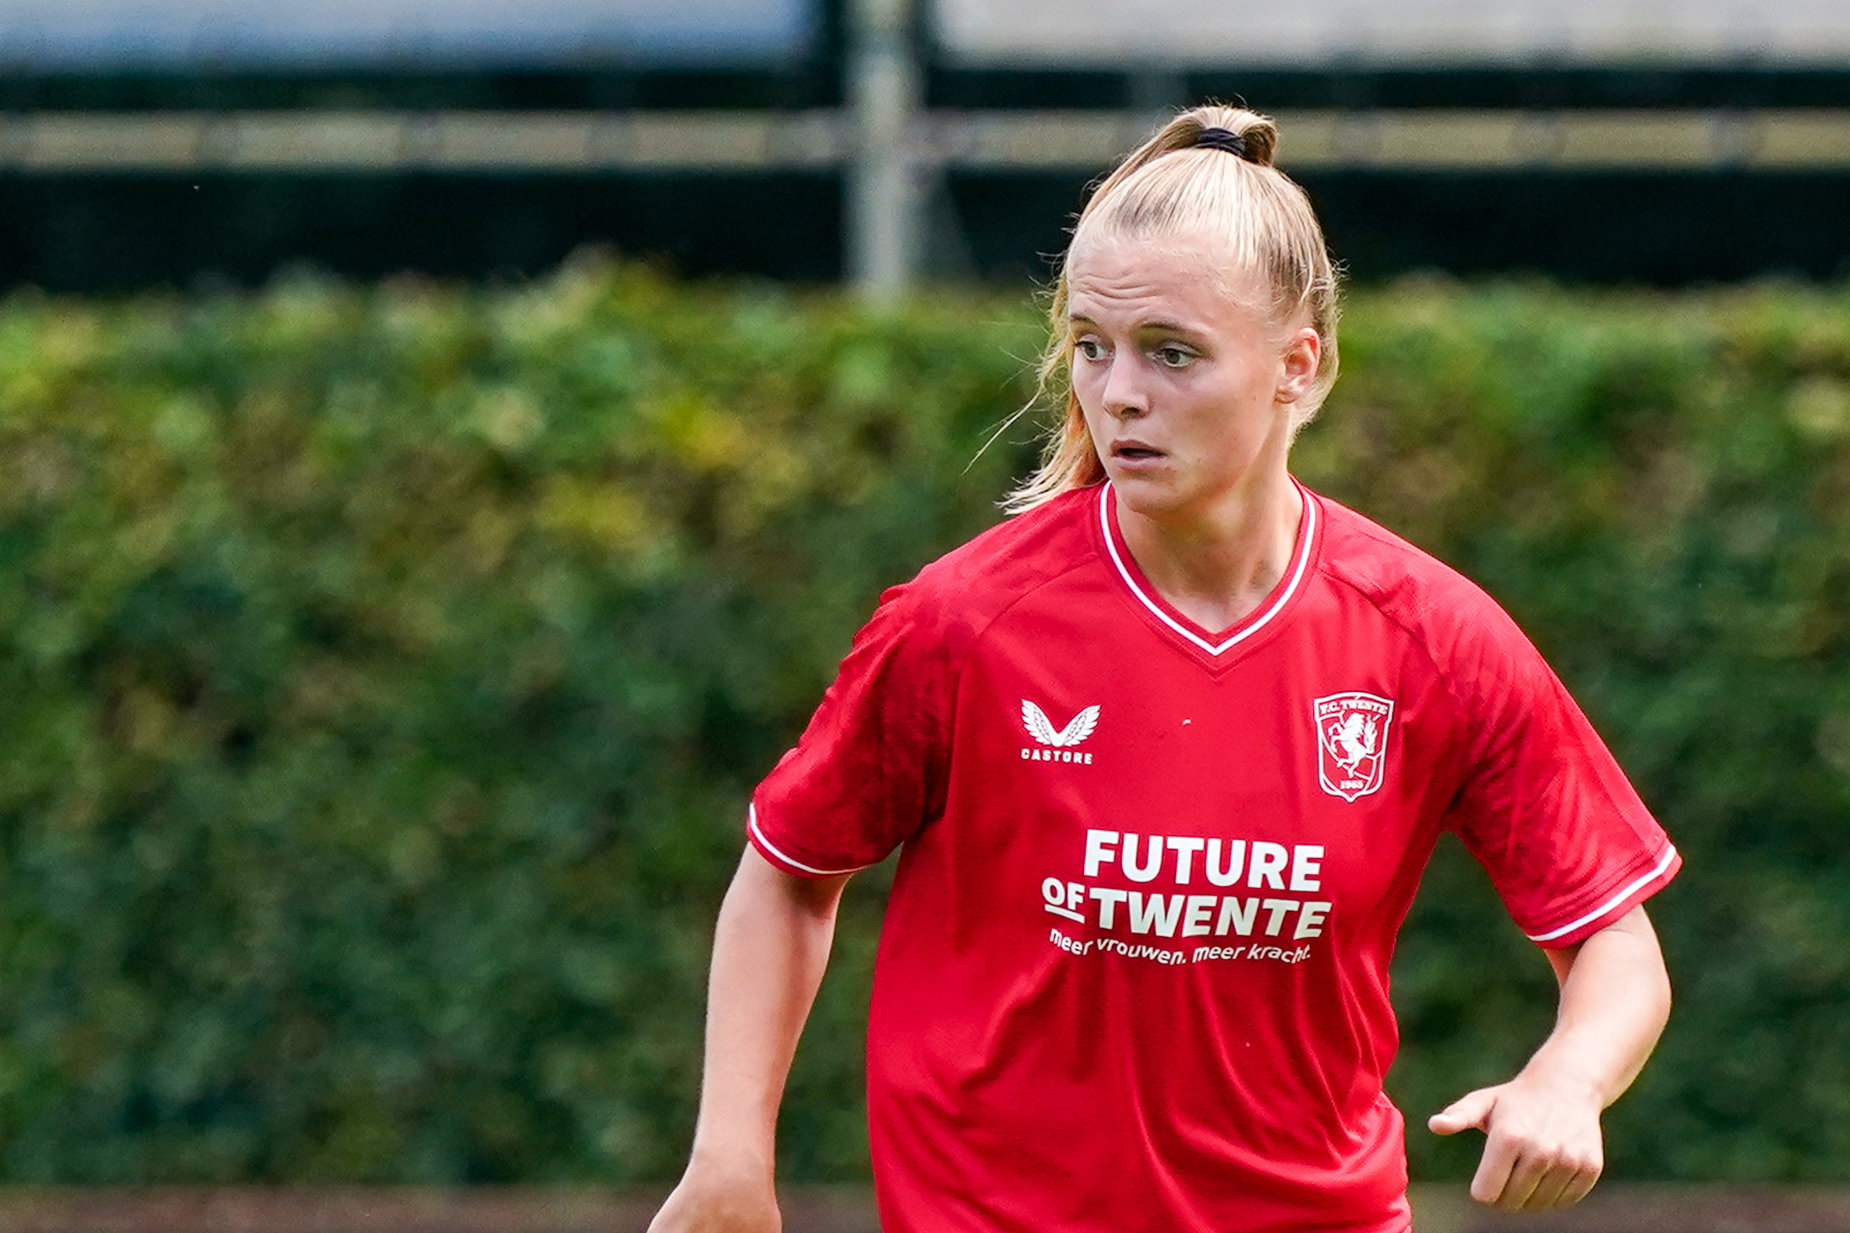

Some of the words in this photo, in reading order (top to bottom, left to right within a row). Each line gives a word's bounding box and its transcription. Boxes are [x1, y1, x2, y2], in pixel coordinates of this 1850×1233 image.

[1341, 701, 1388, 715] TWENTE
[1021, 748, 1093, 764] CASTORE
[1083, 829, 1325, 892] FUTURE
[1042, 877, 1086, 913] OF
[1089, 888, 1332, 941] TWENTE
[1049, 928, 1093, 956] meer
[1097, 937, 1187, 965] vrouwen.
[1192, 946, 1245, 964] meer
[1248, 942, 1311, 965] kracht.
